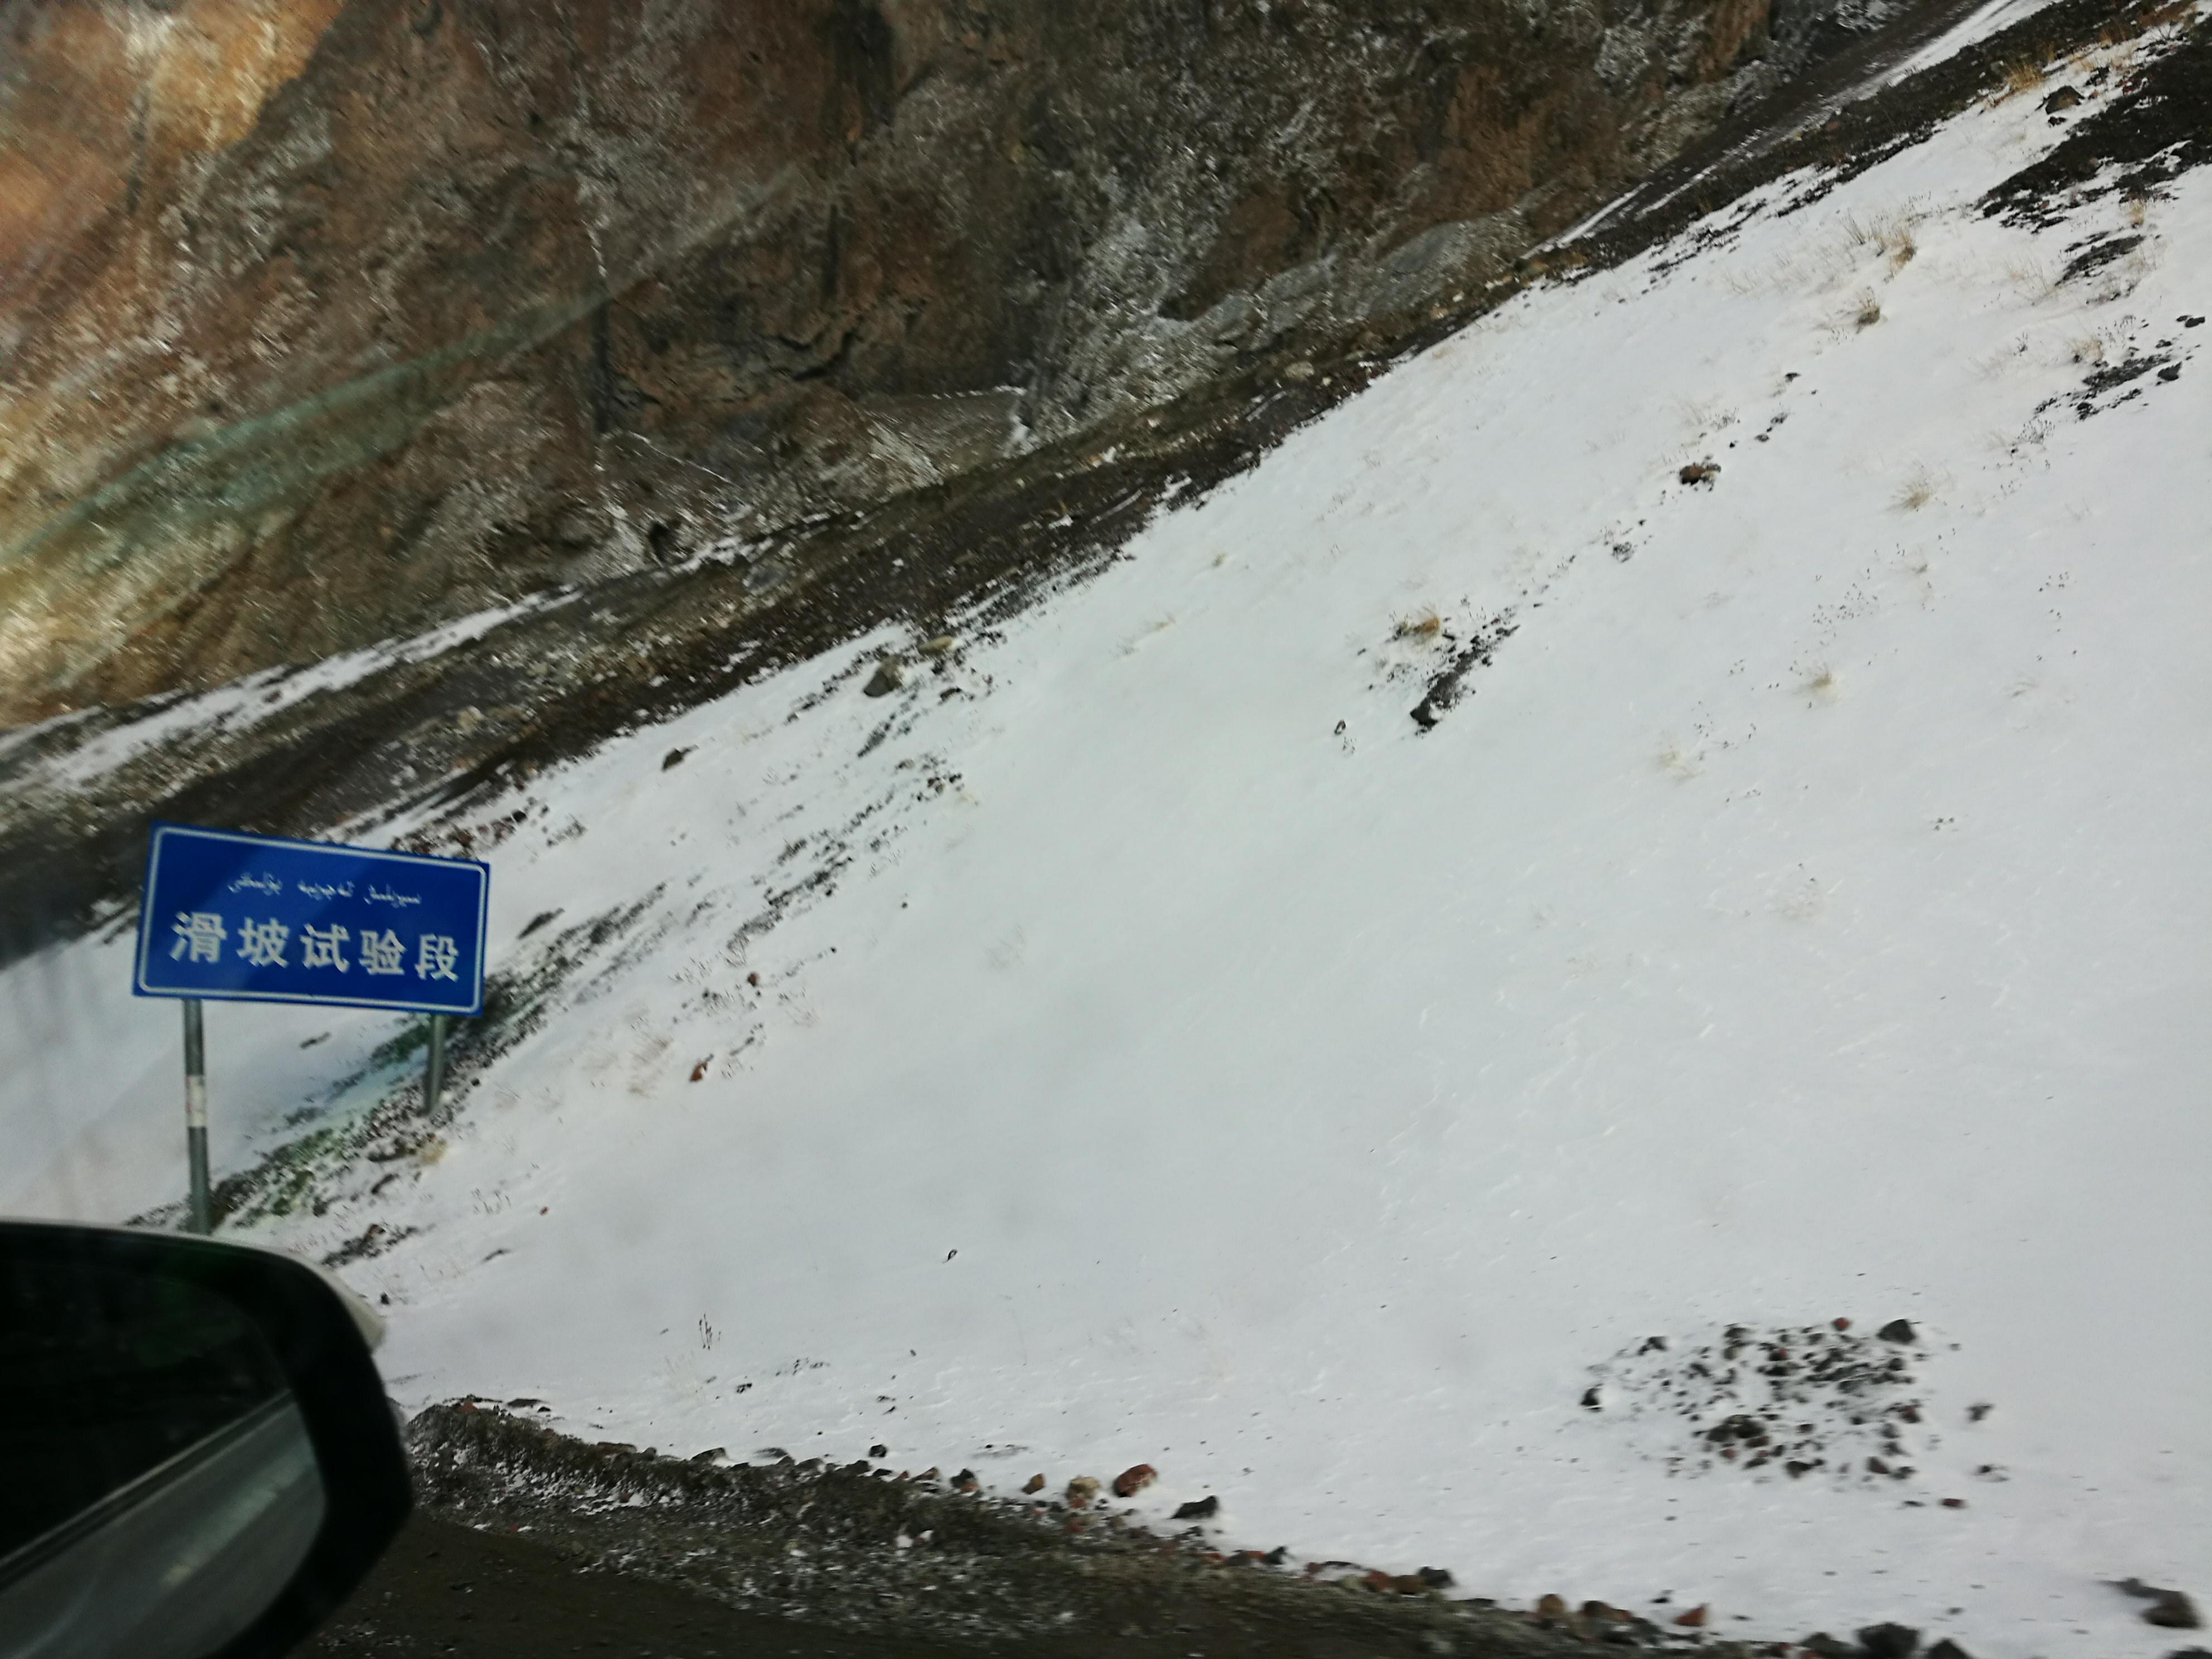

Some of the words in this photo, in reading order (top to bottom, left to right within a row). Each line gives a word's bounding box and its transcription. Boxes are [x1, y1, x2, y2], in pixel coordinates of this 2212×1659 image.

[169, 911, 459, 982] 滑坡试验段
